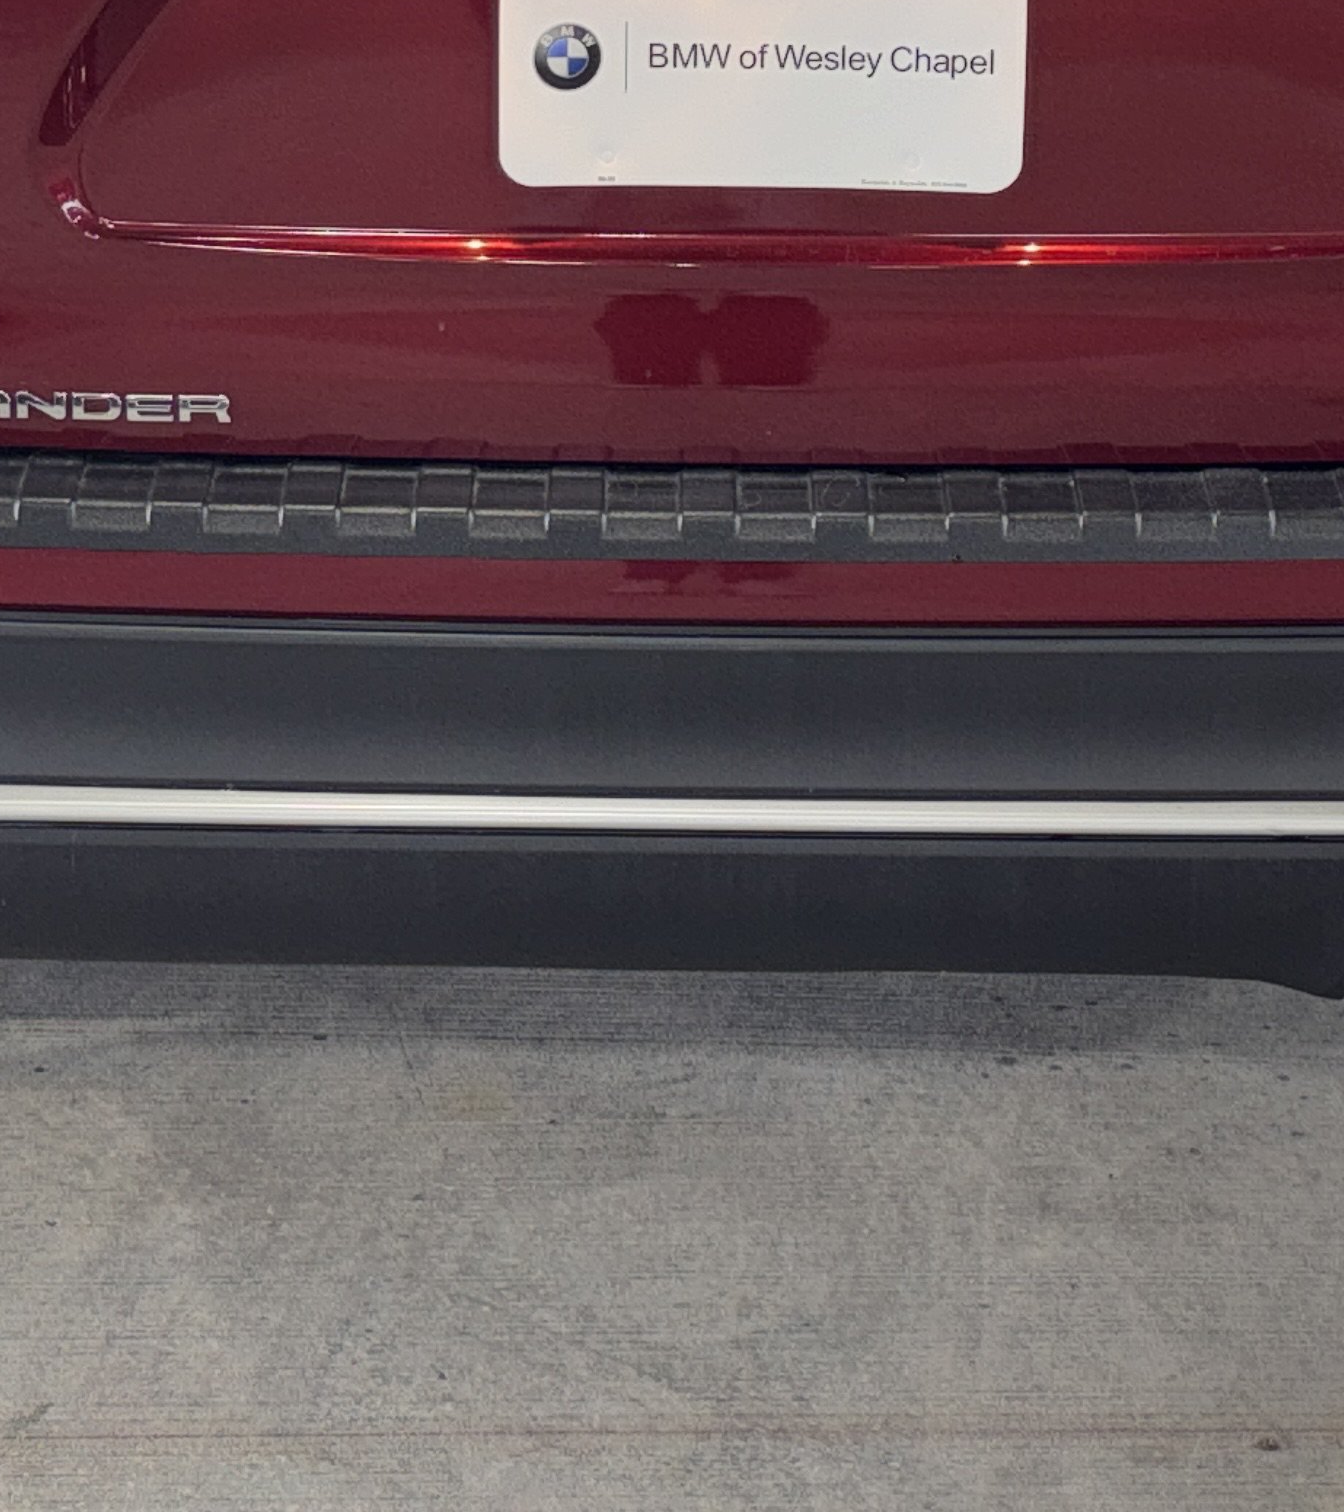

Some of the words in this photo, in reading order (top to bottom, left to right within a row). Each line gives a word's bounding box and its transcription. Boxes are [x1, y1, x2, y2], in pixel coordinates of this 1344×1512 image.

[648, 42, 731, 69] BMW
[739, 43, 768, 71] of
[775, 44, 883, 79] Wesley
[890, 45, 996, 80] Chapel
